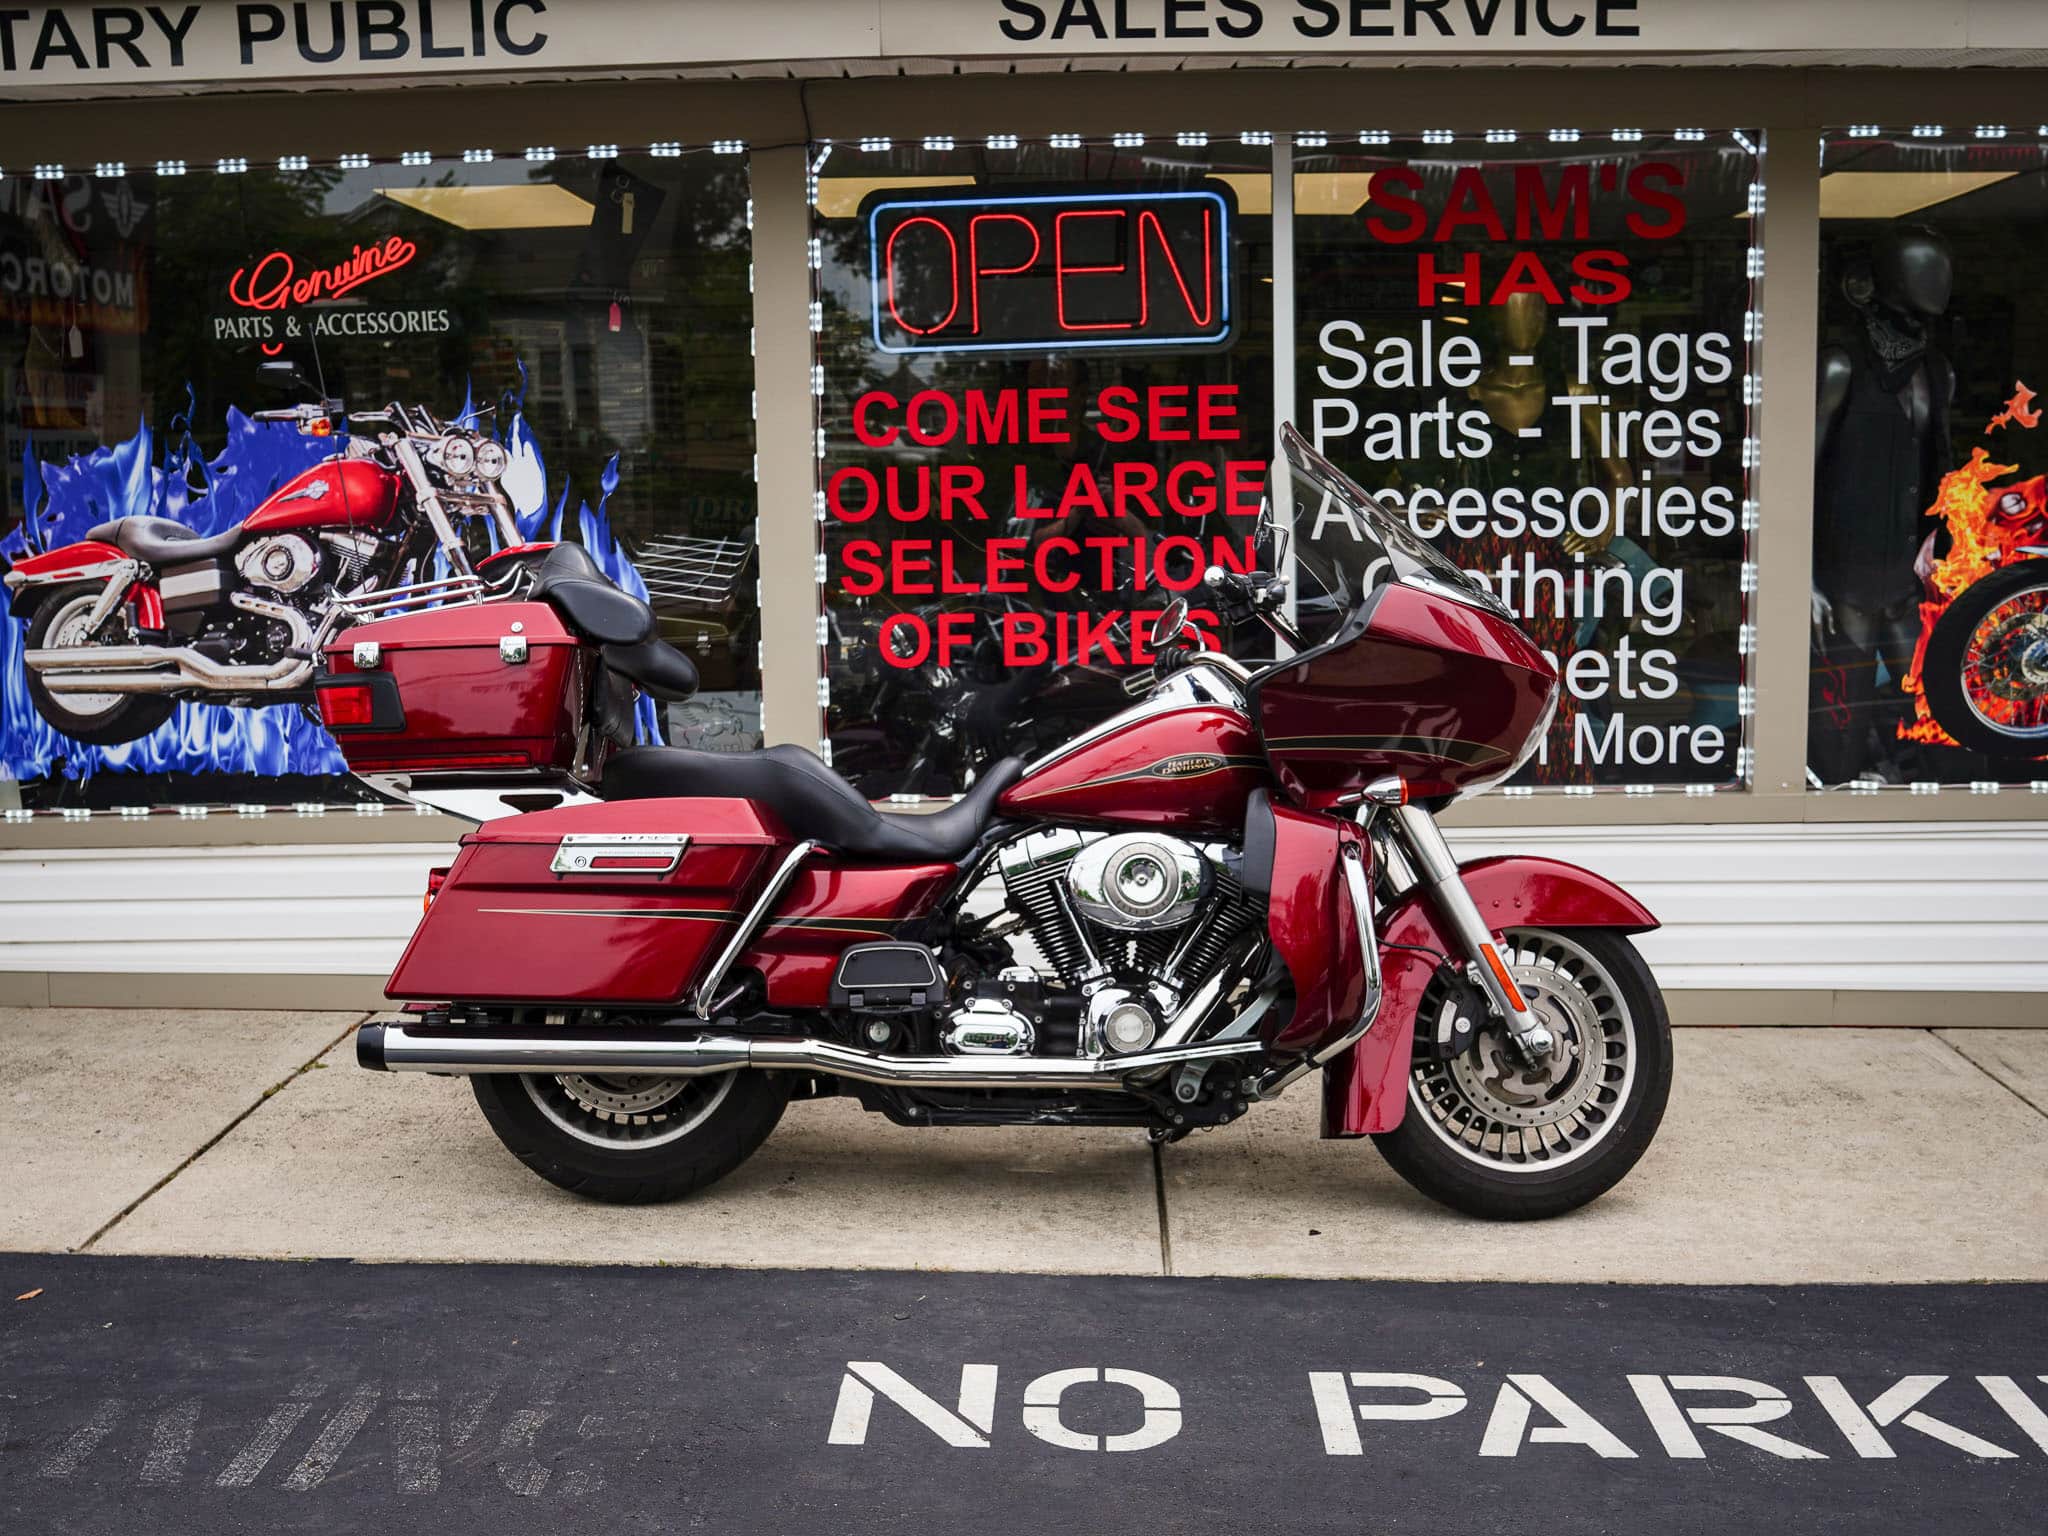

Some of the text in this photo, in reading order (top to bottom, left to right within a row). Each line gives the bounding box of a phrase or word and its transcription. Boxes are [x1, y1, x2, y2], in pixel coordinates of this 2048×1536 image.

[0, 0, 547, 70] TARY PUBLIC
[999, 0, 1639, 40] SALES SERVICE
[1366, 161, 1688, 244] SAM'S
[229, 236, 416, 310] Genuine
[886, 209, 1211, 335] OPEN
[1417, 250, 1633, 307] HAS
[213, 309, 450, 340] PARTS & ACCESSORIES
[1317, 318, 1482, 390] Sale
[1558, 316, 1733, 403] Tags
[852, 384, 1241, 448] COME SEE
[1312, 397, 1494, 462] Parts
[1551, 395, 1722, 460] Tires
[827, 460, 1267, 523] OUR LARGE
[1310, 470, 1736, 542] Accessories
[840, 534, 1258, 597] SELECTION
[878, 608, 1222, 669] OF BIKES
[1574, 712, 1726, 766] More
[828, 1361, 2048, 1460] NO PARKI
